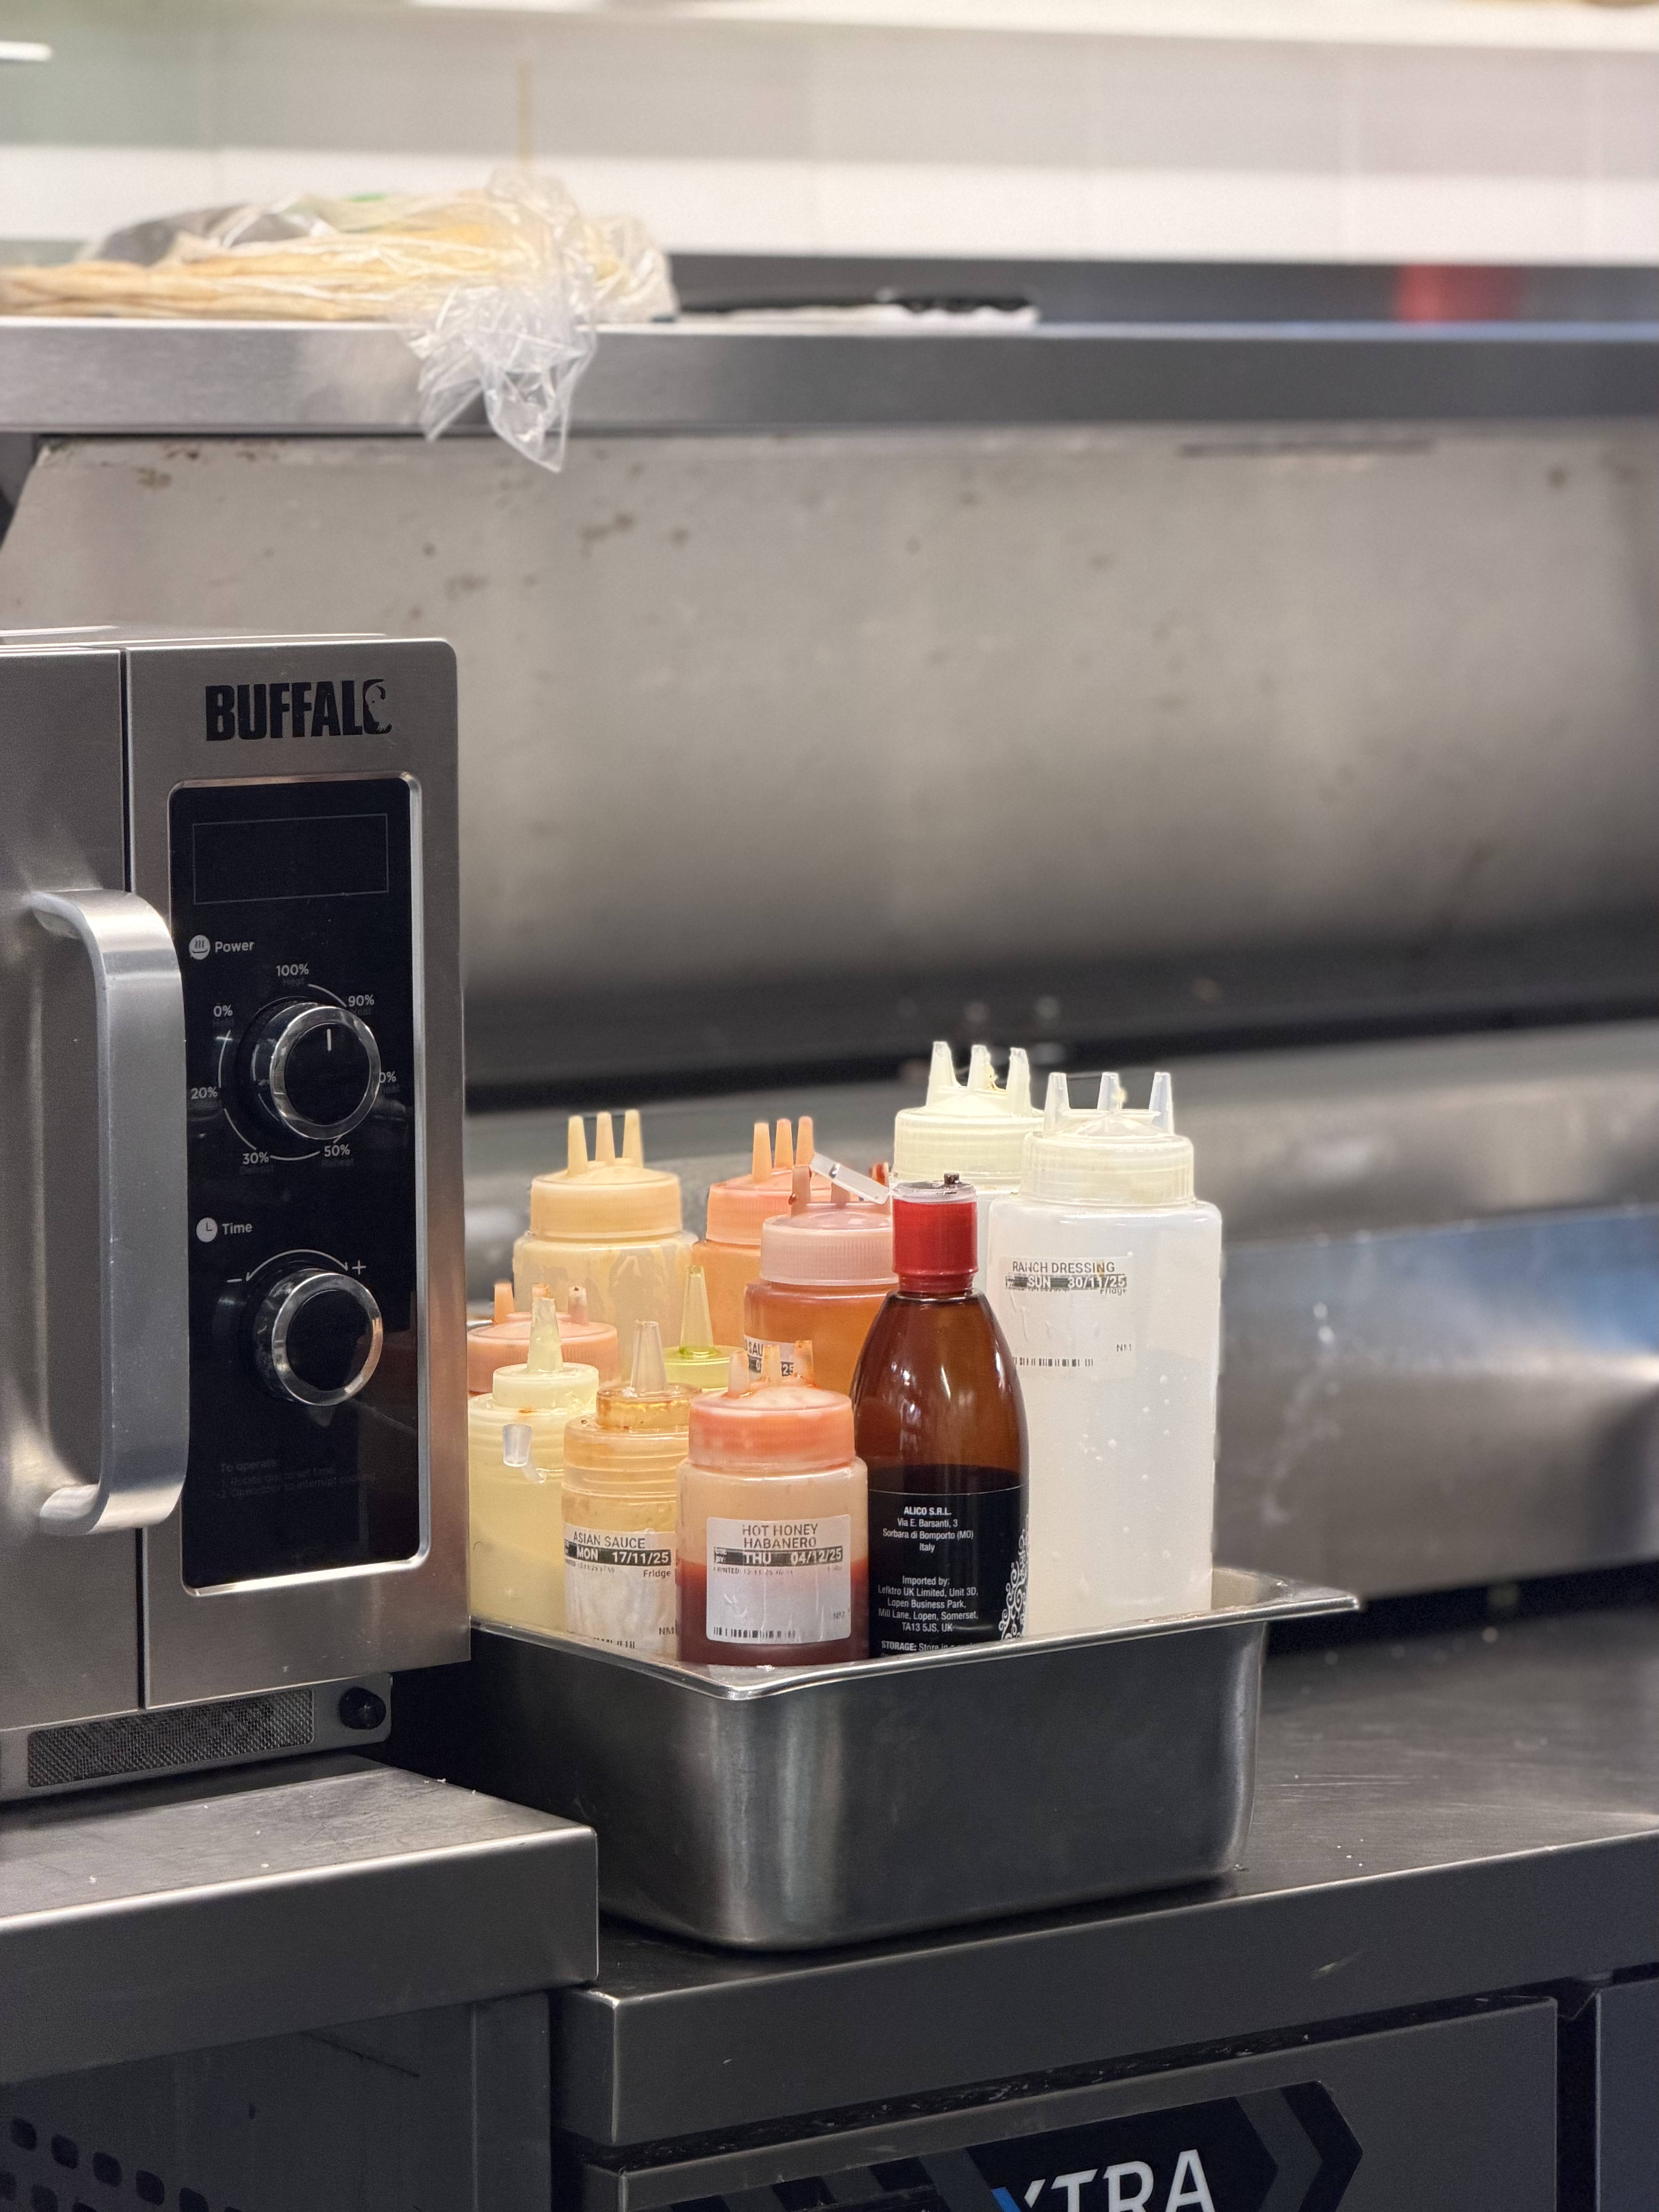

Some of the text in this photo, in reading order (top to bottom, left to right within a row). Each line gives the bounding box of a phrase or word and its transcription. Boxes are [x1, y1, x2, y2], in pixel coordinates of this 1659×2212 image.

[204, 678, 392, 742] BUFFALO
[214, 941, 254, 953] Power
[276, 963, 309, 977] 100%
[348, 994, 375, 1007] 90%
[213, 1004, 233, 1017] 0%
[379, 1071, 396, 1084] 0%
[191, 1086, 218, 1099] 20%
[324, 1143, 350, 1157] 50%
[242, 1151, 269, 1164] 30%
[222, 1222, 253, 1235] Time
[1013, 1261, 1115, 1274] RANCH DRESSING
[1027, 1276, 1051, 1288] SUN
[1068, 1276, 1126, 1288] 30/11/25
[749, 1342, 763, 1356] SAU
[903, 1506, 952, 1516] ALICO S.R.L.
[742, 1523, 818, 1536] HOT HONEY
[897, 1518, 958, 1528] Via E. Barsanti, 3
[573, 1531, 646, 1549] ASIAN SAUCE
[882, 1528, 974, 1541] Sorbara di Bomporto (MO)
[744, 1537, 816, 1549] HABANERO
[919, 1543, 935, 1553] Italy
[576, 1546, 599, 1561] MON
[612, 1551, 670, 1564] 17/11/25
[743, 1547, 842, 1565] THU 04/12/25
[643, 1569, 671, 1579] Fridge
[902, 1575, 950, 1587] Imported by:
[903, 1587, 914, 1596] UK
[916, 1588, 947, 1598] Limited,
[949, 1587, 965, 1597] Unit
[966, 1587, 979, 1596] 3D,
[887, 1597, 967, 1609] Lopen Business Park,
[878, 1607, 979, 1621] Mill Lane, Lopen, Somerset,
[902, 1621, 953, 1633] TA13 5JS, UK
[881, 1640, 917, 1651] STORAGE:
[918, 1643, 939, 1652] Store
